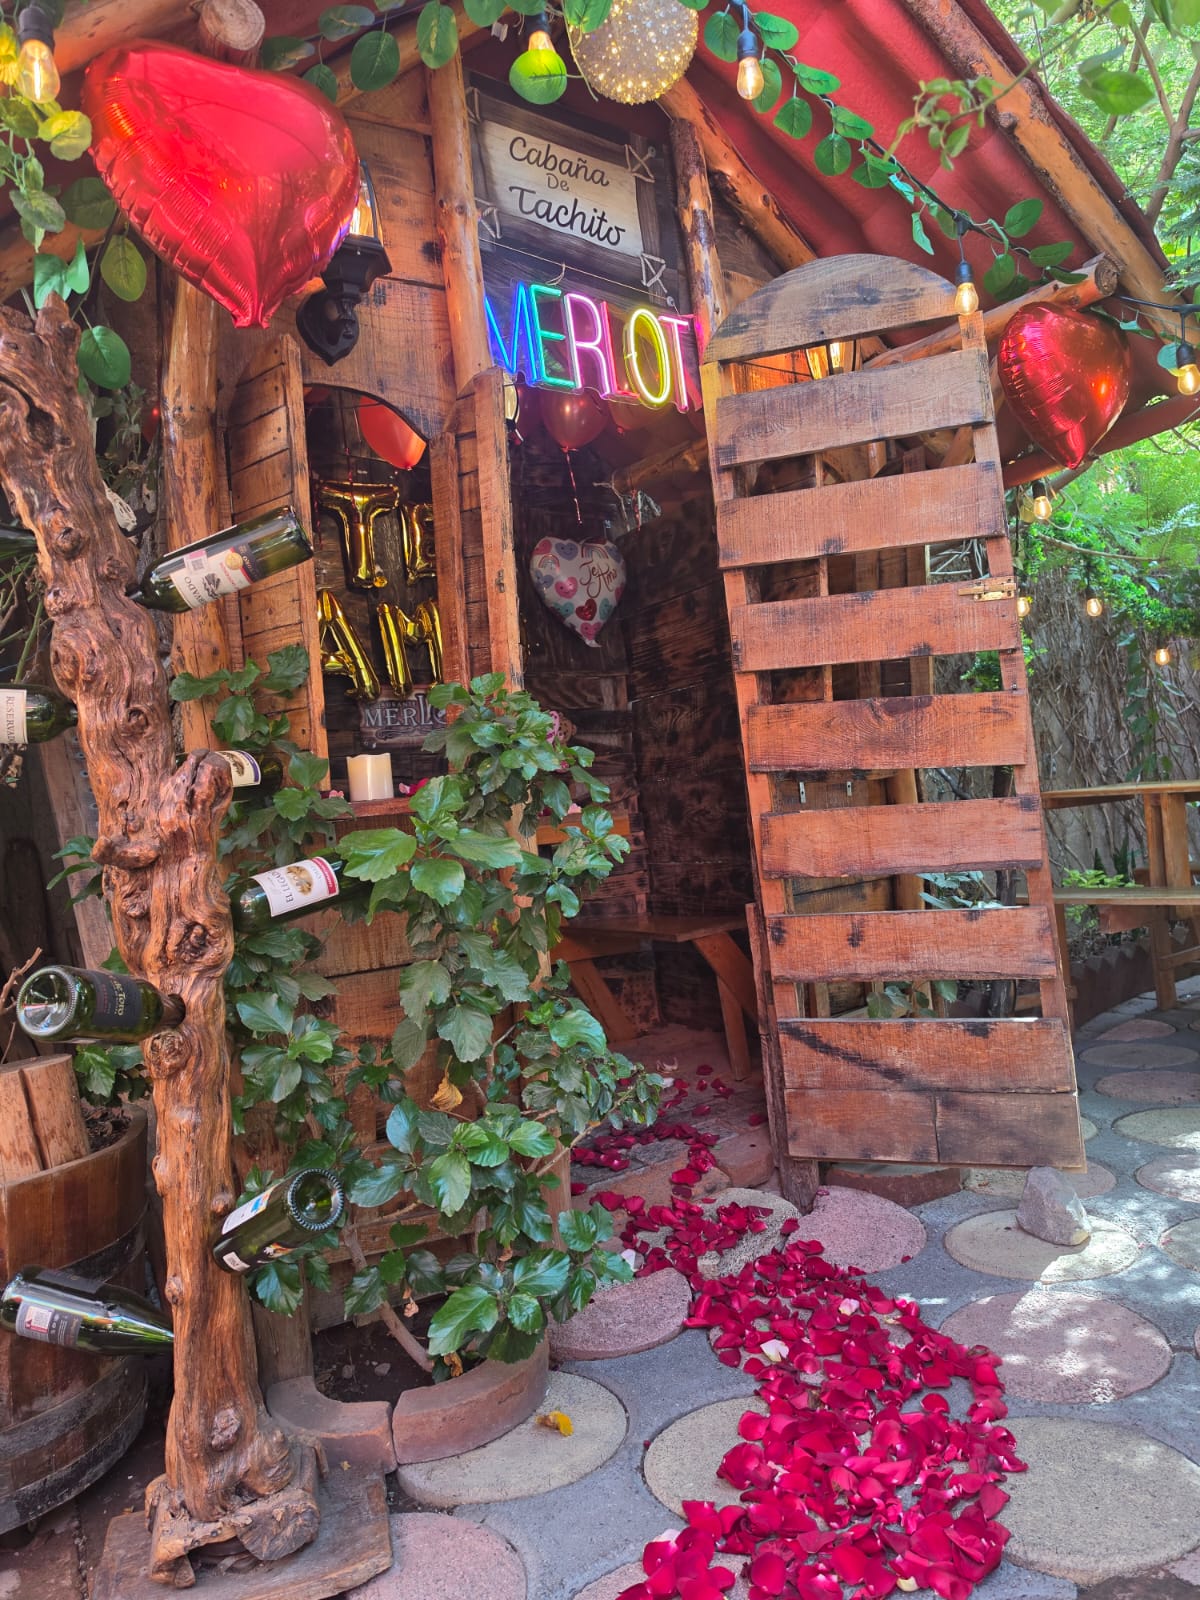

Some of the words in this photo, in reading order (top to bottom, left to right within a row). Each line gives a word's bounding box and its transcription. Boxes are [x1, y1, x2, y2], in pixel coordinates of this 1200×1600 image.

[508, 136, 610, 187] Cabaña
[547, 173, 570, 192] De
[509, 186, 626, 247] Tachito
[484, 282, 694, 412] MERLOT
[318, 590, 442, 701] AM
[6, 695, 16, 743] RESERVAD
